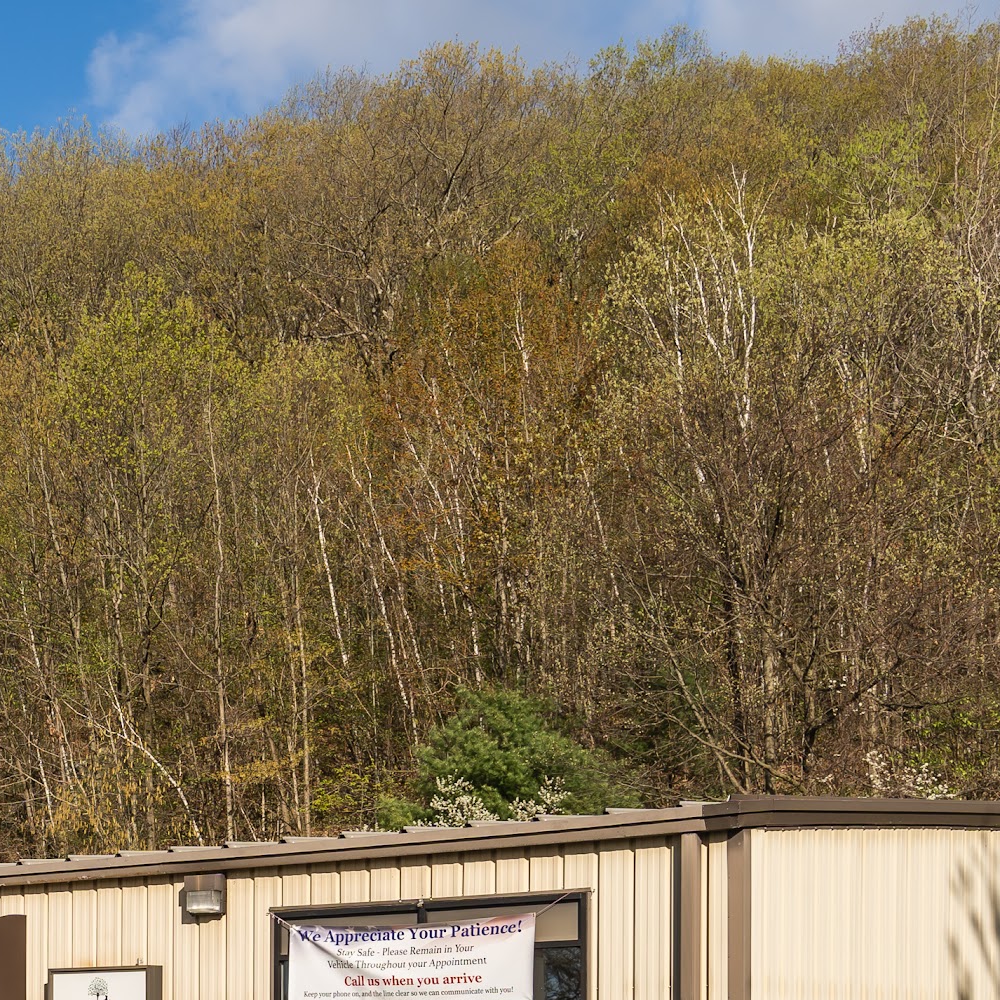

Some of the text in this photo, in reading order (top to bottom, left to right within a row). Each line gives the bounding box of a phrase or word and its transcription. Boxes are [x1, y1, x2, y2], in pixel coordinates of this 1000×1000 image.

[298, 920, 522, 946] We Appreciate Your Patience!
[336, 948, 356, 957] Stay
[357, 947, 375, 957] Safe
[382, 947, 408, 956] Please
[410, 945, 442, 955] Remain
[444, 945, 453, 954] in
[455, 944, 475, 953] Your
[327, 957, 487, 971] Vehicle Throughout your Appointment
[344, 972, 483, 988] Call us when you arrive
[333, 990, 351, 998] phone
[485, 986, 499, 994] with
[499, 986, 514, 994] you!
